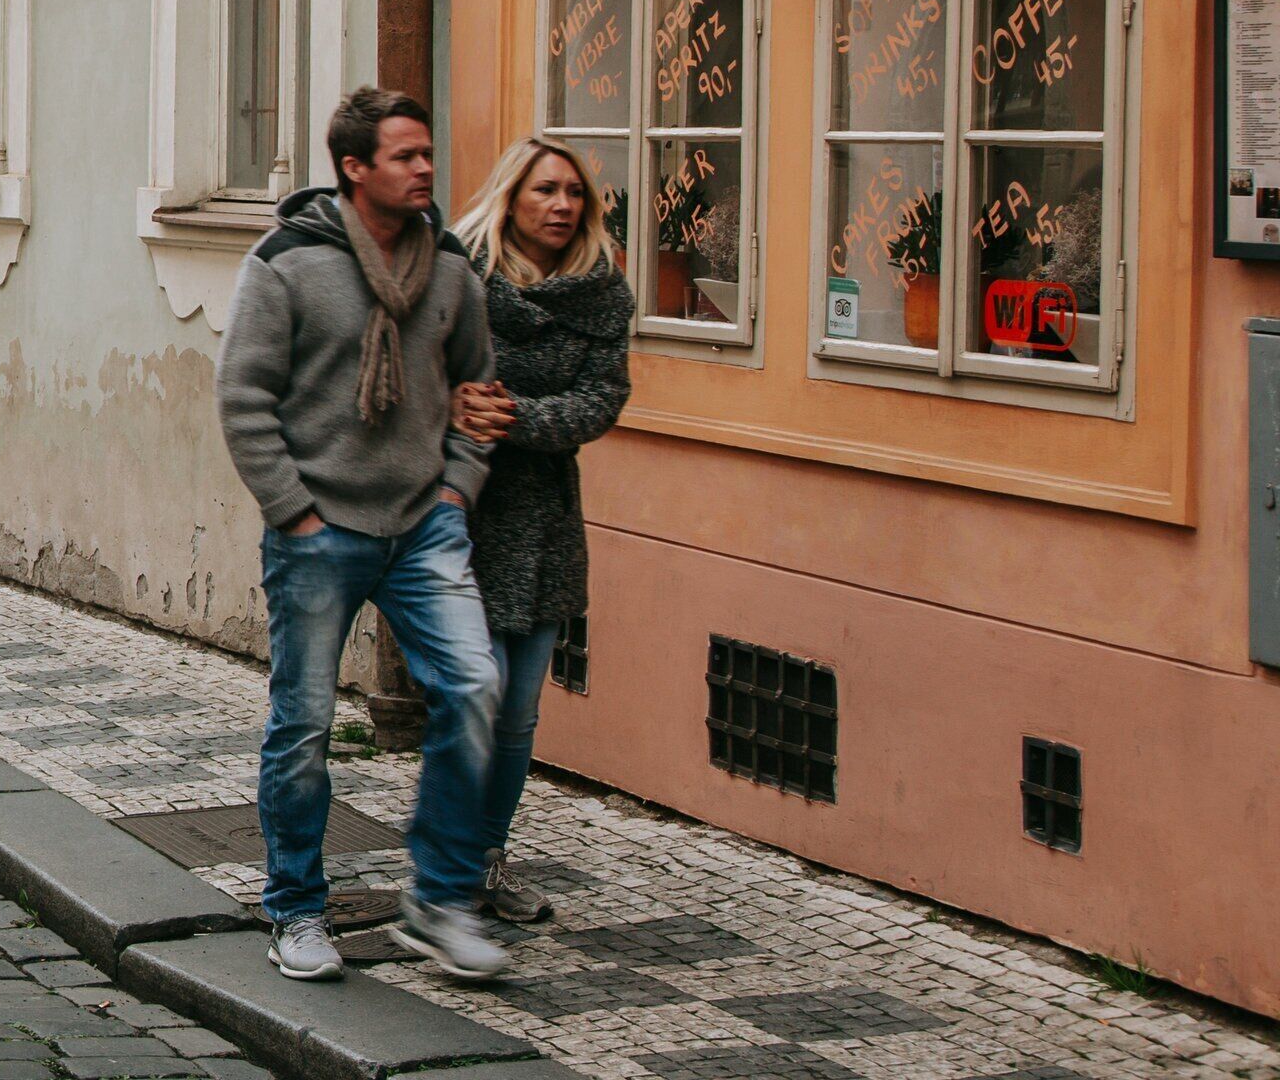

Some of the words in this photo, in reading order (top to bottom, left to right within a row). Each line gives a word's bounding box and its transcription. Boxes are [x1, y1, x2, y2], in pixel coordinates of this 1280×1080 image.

[565, 15, 624, 88] LIBRE
[657, 10, 727, 102] SPRITZ
[654, 149, 715, 223] BEER
[831, 156, 903, 274] CAKES
[972, 180, 1031, 249] TEA
[866, 186, 932, 276] FROM
